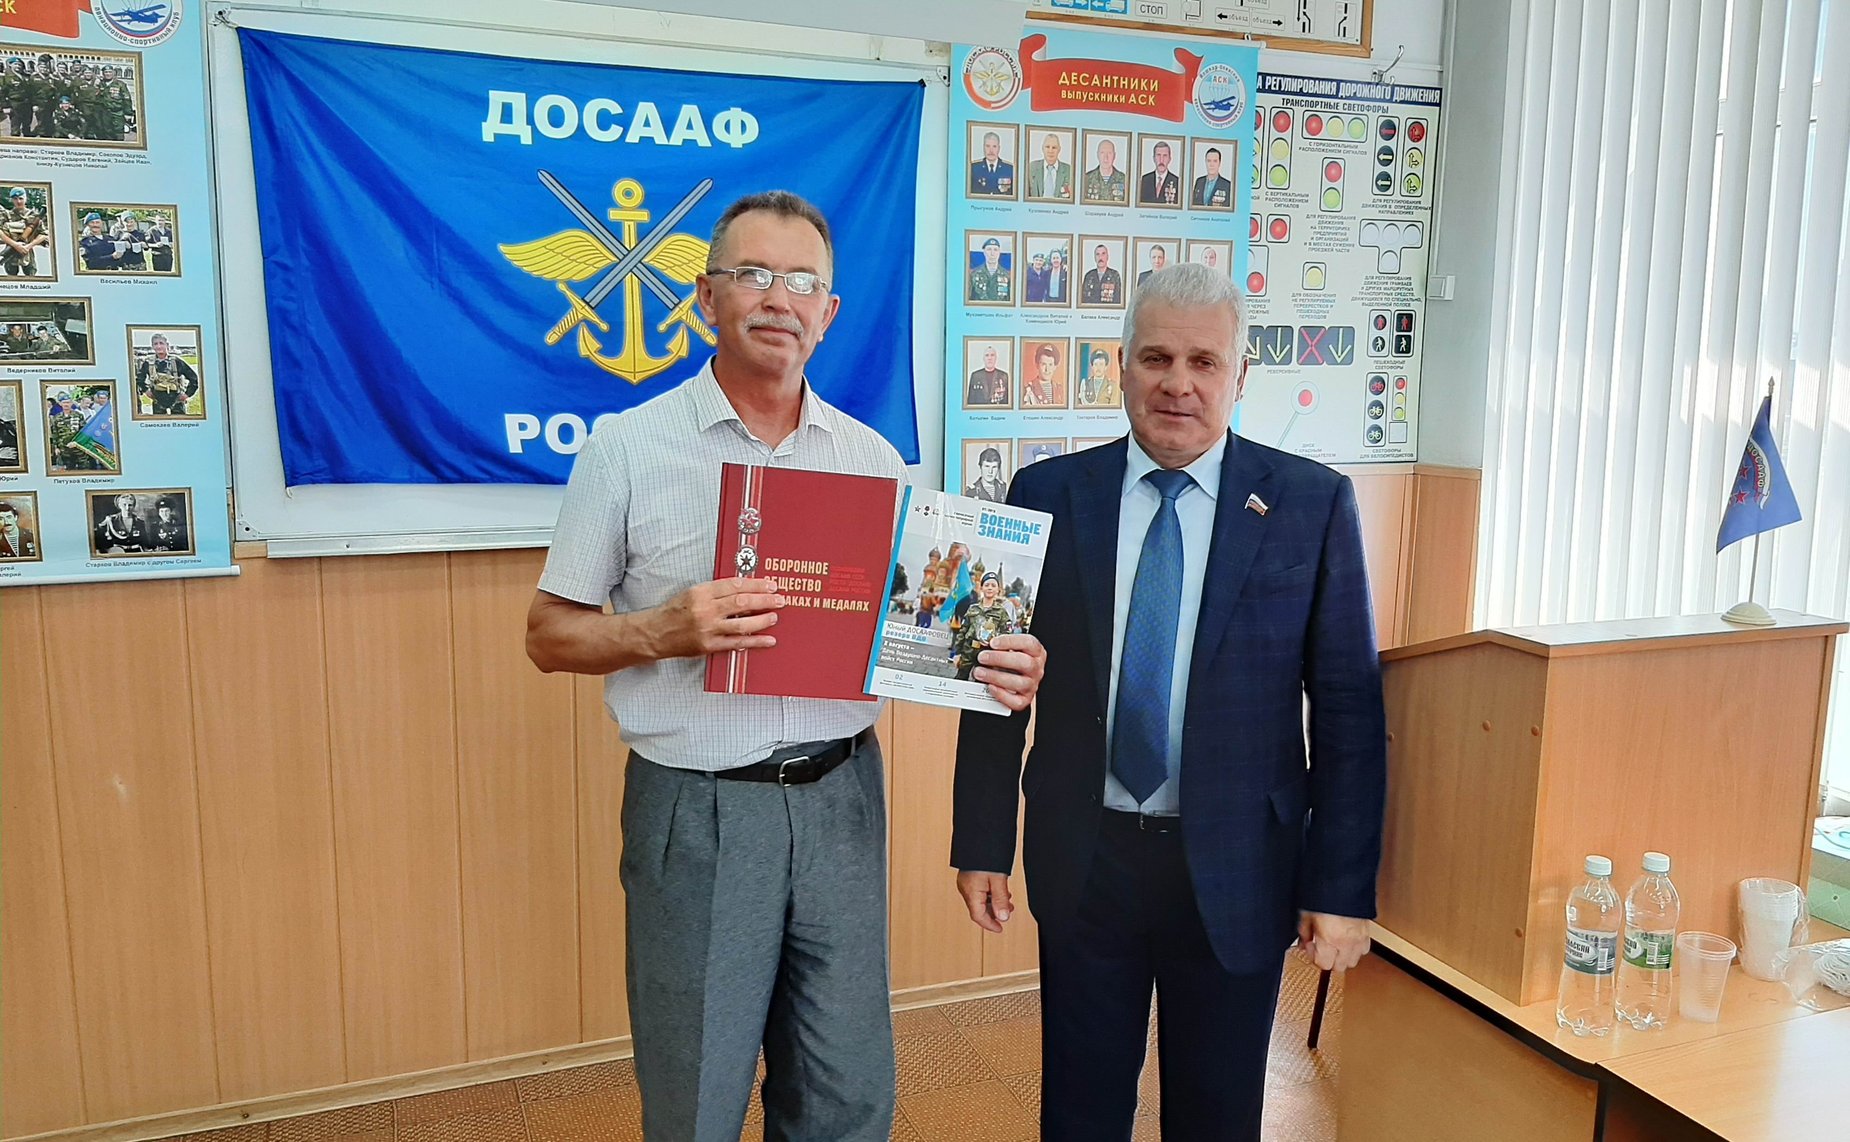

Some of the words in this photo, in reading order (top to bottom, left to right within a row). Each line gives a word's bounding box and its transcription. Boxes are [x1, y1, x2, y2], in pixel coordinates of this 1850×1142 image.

[1139, 4, 1164, 15] СТОП
[1058, 71, 1159, 92] ДЕСАНТНИКИ
[1265, 76, 1337, 96] РЕГУЛИРОВАНИЯ
[1338, 82, 1392, 100] ДОРОЖНОГО
[1392, 86, 1441, 104] ДВИЖЕНИЯ
[1061, 90, 1126, 103] выпускники
[1128, 93, 1156, 106] АСК
[1281, 97, 1340, 111] ТРАНСПОРТНЫЕ
[1342, 103, 1389, 114] СВЕТОФОРЫ
[482, 90, 759, 148] ДОСААФ
[979, 512, 1042, 535] ВОЕННЫЕ
[977, 524, 1031, 545] ЗНАНИЯ
[764, 557, 829, 575] ОБОРОННОЕ
[783, 595, 812, 608] АКАХ
[813, 597, 820, 608] И
[822, 597, 870, 612] МЕДАЛЯХ
